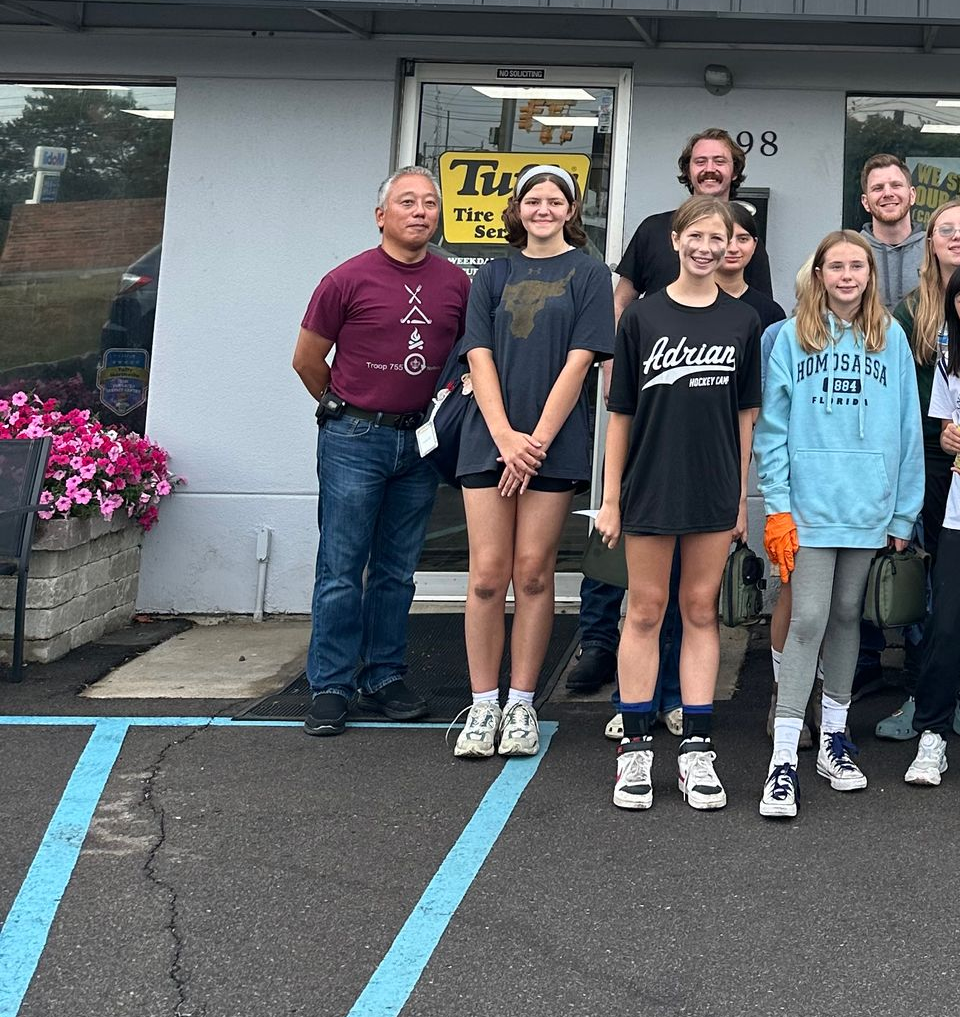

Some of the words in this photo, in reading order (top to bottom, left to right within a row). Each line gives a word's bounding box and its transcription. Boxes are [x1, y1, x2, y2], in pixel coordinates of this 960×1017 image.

[509, 70, 543, 78] SOLICITING
[917, 163, 941, 187] WE
[454, 207, 494, 222] Tire
[643, 336, 736, 375] Adrian
[366, 361, 388, 371] Troop
[389, 363, 404, 371] 755
[689, 377, 715, 388] HOCKEY
